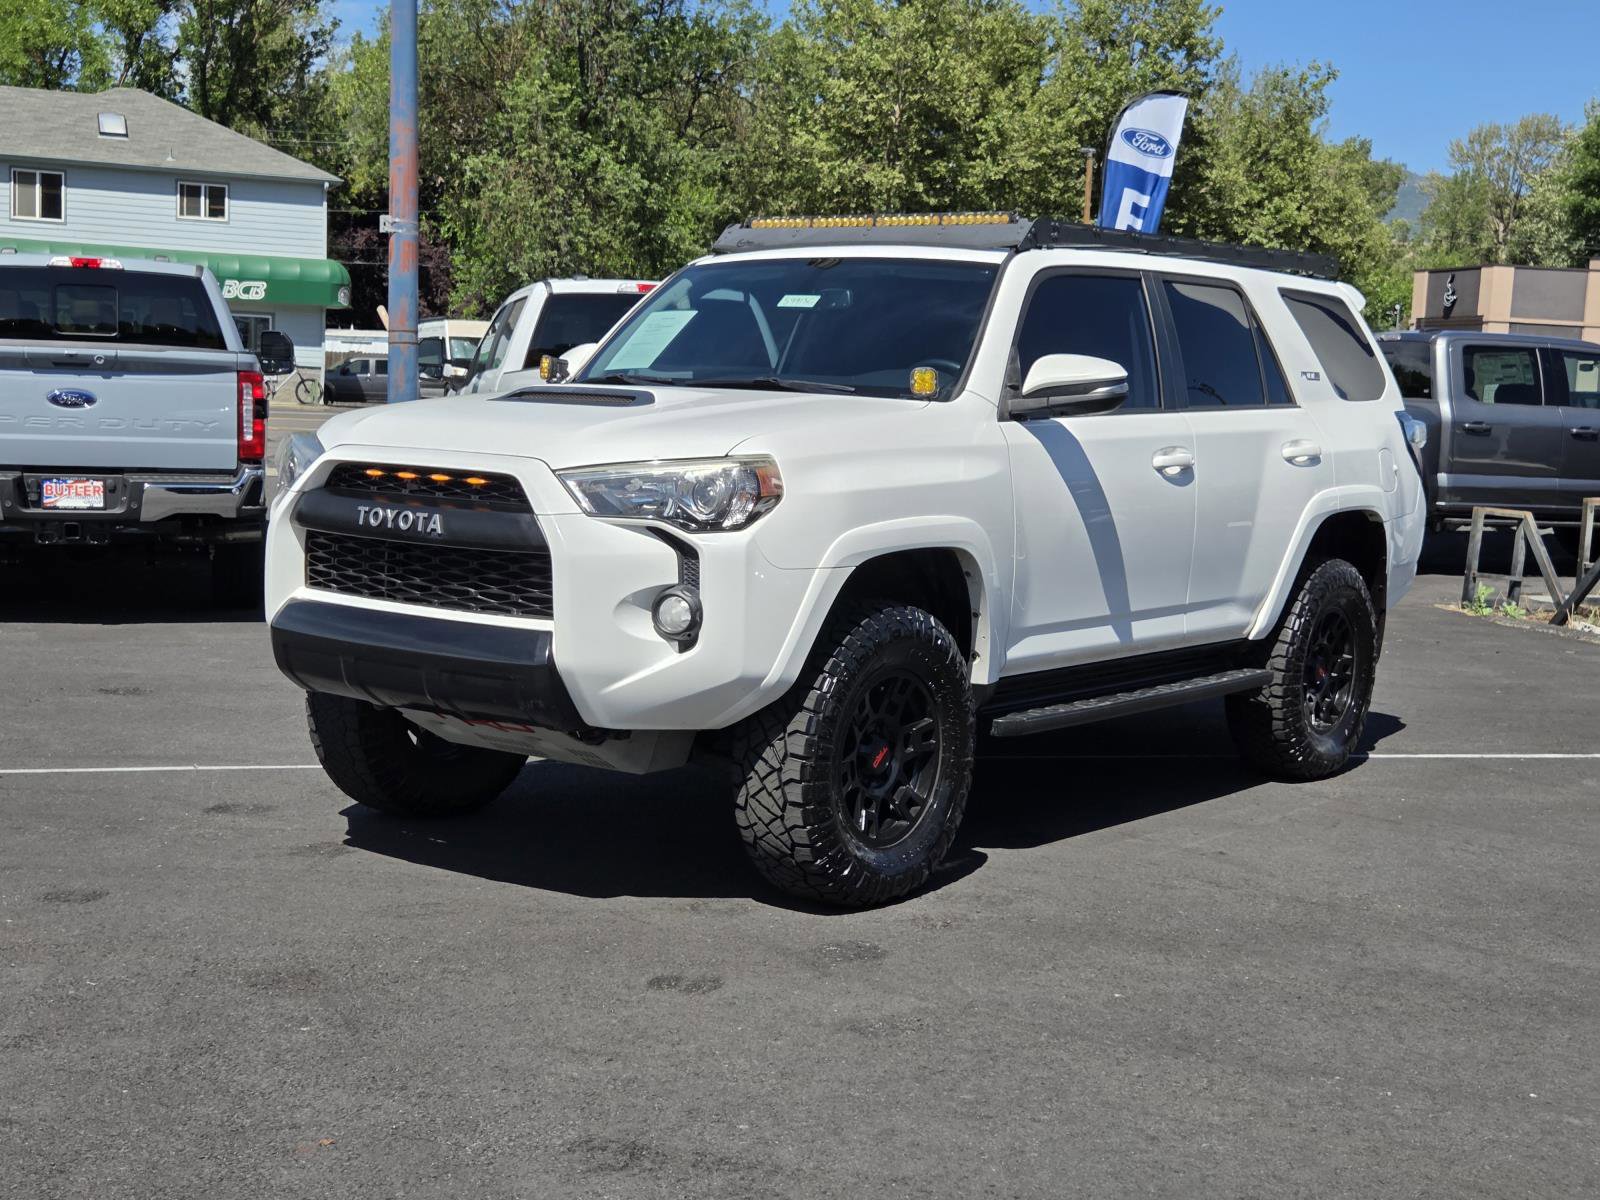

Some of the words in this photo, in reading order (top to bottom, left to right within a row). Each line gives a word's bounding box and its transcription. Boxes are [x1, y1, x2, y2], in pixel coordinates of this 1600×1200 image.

[1132, 131, 1166, 156] Ford
[98, 416, 220, 432] DUTY
[43, 483, 104, 497] BUTLER
[357, 505, 443, 535] TOYOTA
